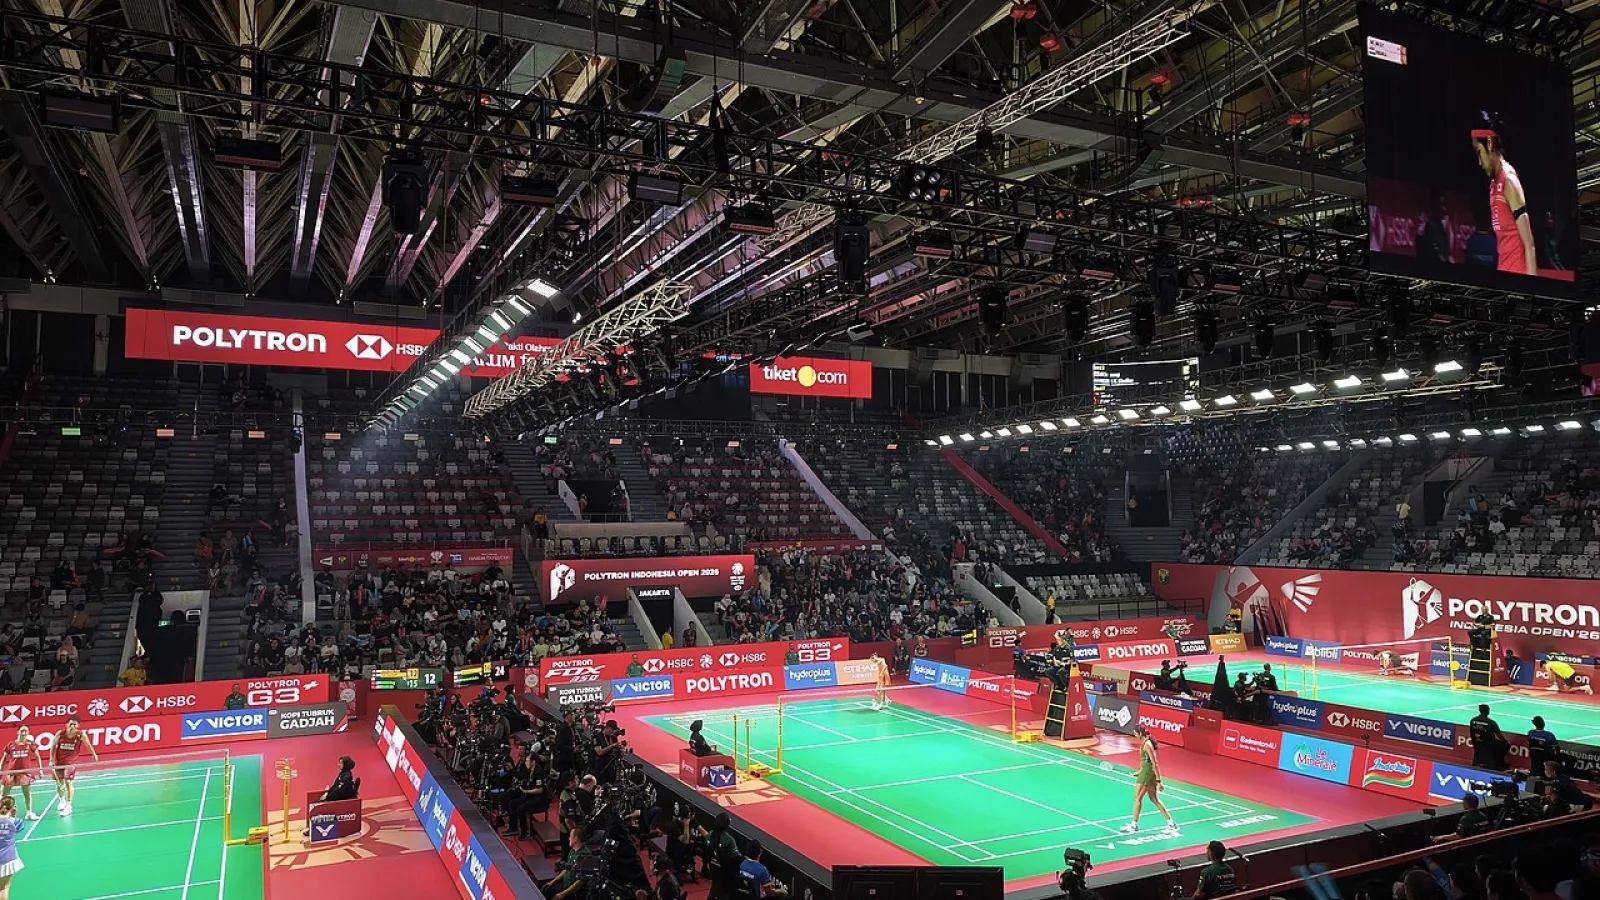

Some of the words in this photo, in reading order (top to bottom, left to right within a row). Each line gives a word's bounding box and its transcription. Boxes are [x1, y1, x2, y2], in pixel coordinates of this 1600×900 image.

[173, 325, 327, 354] POLYTRON
[584, 571, 630, 581] POLYTRON
[631, 569, 676, 580] INDONESIA
[677, 568, 700, 578] OPEN
[638, 589, 671, 598] JAKARTA
[1448, 598, 1600, 627] POLYTRON
[989, 629, 1017, 637] POLYTRON
[1119, 626, 1138, 635] HSBC
[797, 641, 831, 650] POLYTRON
[1107, 643, 1169, 659] POLYTRON
[742, 652, 767, 663] HSBC
[798, 648, 831, 662] G3
[552, 659, 593, 669] POLYTRON
[667, 658, 693, 669] HSBC
[495, 665, 505, 677] 24
[789, 667, 831, 681] hydroplus
[248, 678, 300, 691] POLYTRON
[424, 673, 436, 684] 12
[686, 672, 774, 694] POLYTRON
[629, 680, 671, 693] VICTOR
[968, 679, 1000, 693] POLYTRON
[1074, 682, 1080, 693] 1
[156, 694, 196, 709] HSBC
[247, 688, 300, 706] G3
[559, 693, 603, 705] GADJAH
[34, 703, 78, 718] HSBC
[280, 711, 301, 719] KOPI
[302, 707, 334, 719] TUBRUK
[1272, 699, 1317, 718] hydroplus
[206, 713, 264, 730] VICTOR
[280, 715, 334, 730] GADJAH
[1351, 717, 1381, 732] HSBC
[1404, 721, 1452, 740] VICTOR
[1315, 747, 1327, 758] Le
[1297, 753, 1338, 772] Minerale
